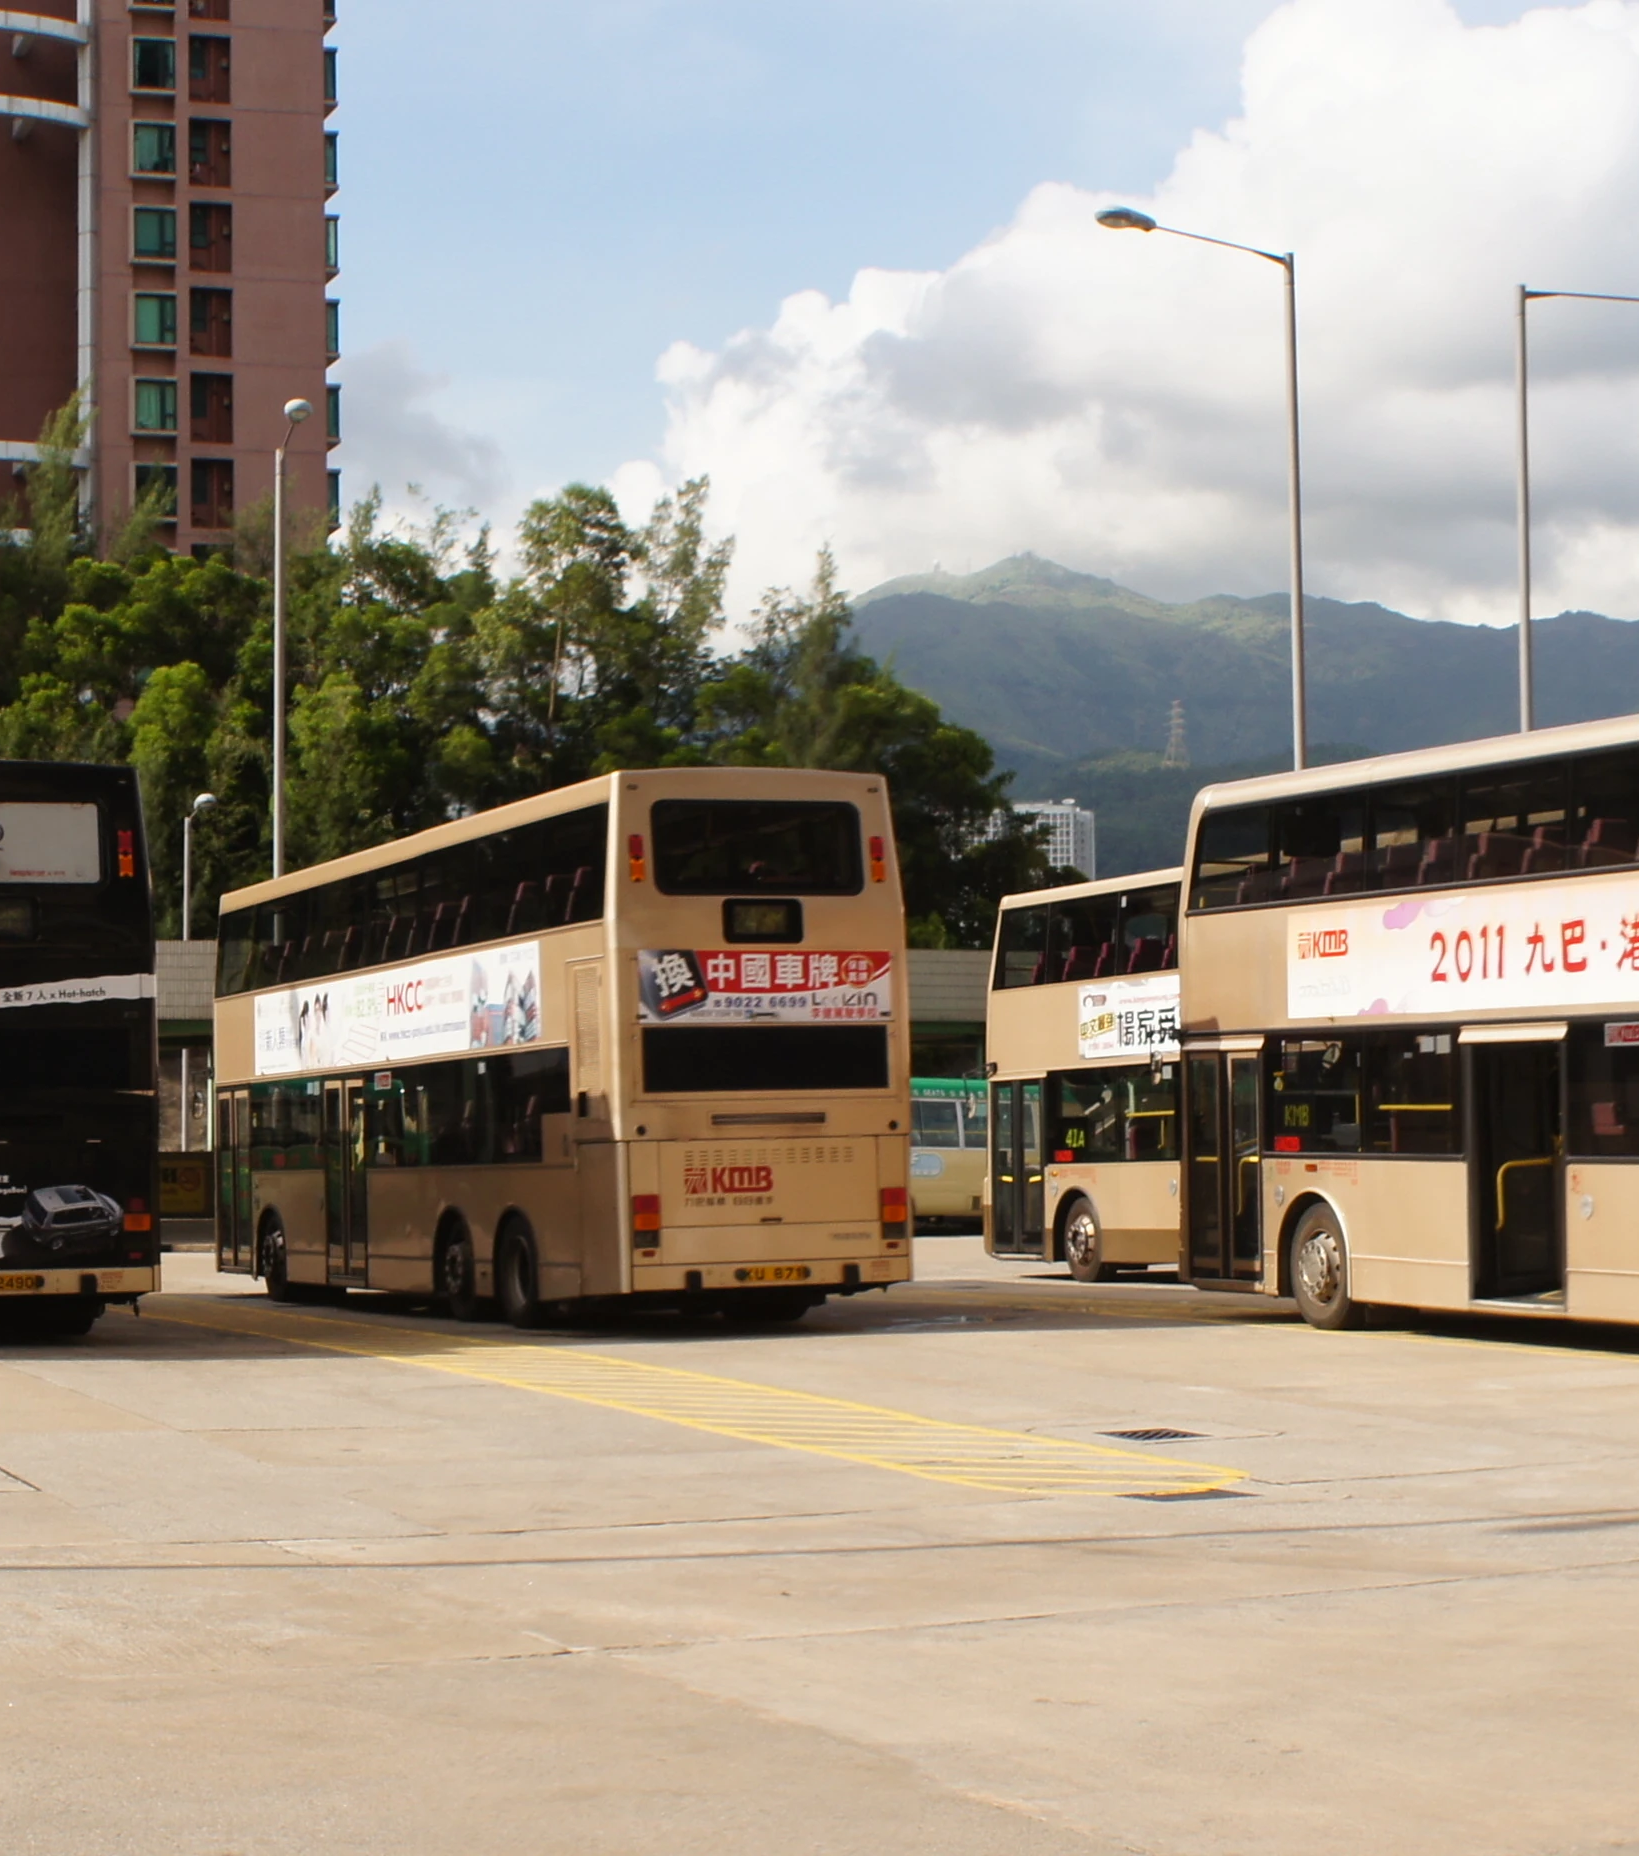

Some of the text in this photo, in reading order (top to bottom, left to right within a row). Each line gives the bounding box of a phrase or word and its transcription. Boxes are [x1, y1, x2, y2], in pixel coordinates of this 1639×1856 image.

[1313, 929, 1349, 959] KMB
[1430, 924, 1506, 983] 2011
[651, 955, 696, 998] 換
[707, 953, 839, 989] 中國車牌
[59, 987, 106, 999] Hot-hatch
[387, 979, 424, 1017] HKCC
[724, 996, 762, 1008] 9022
[769, 996, 807, 1008] 6699
[1284, 1104, 1310, 1128] KMB
[1065, 1128, 1085, 1148] 41A
[711, 1166, 774, 1194] KMB
